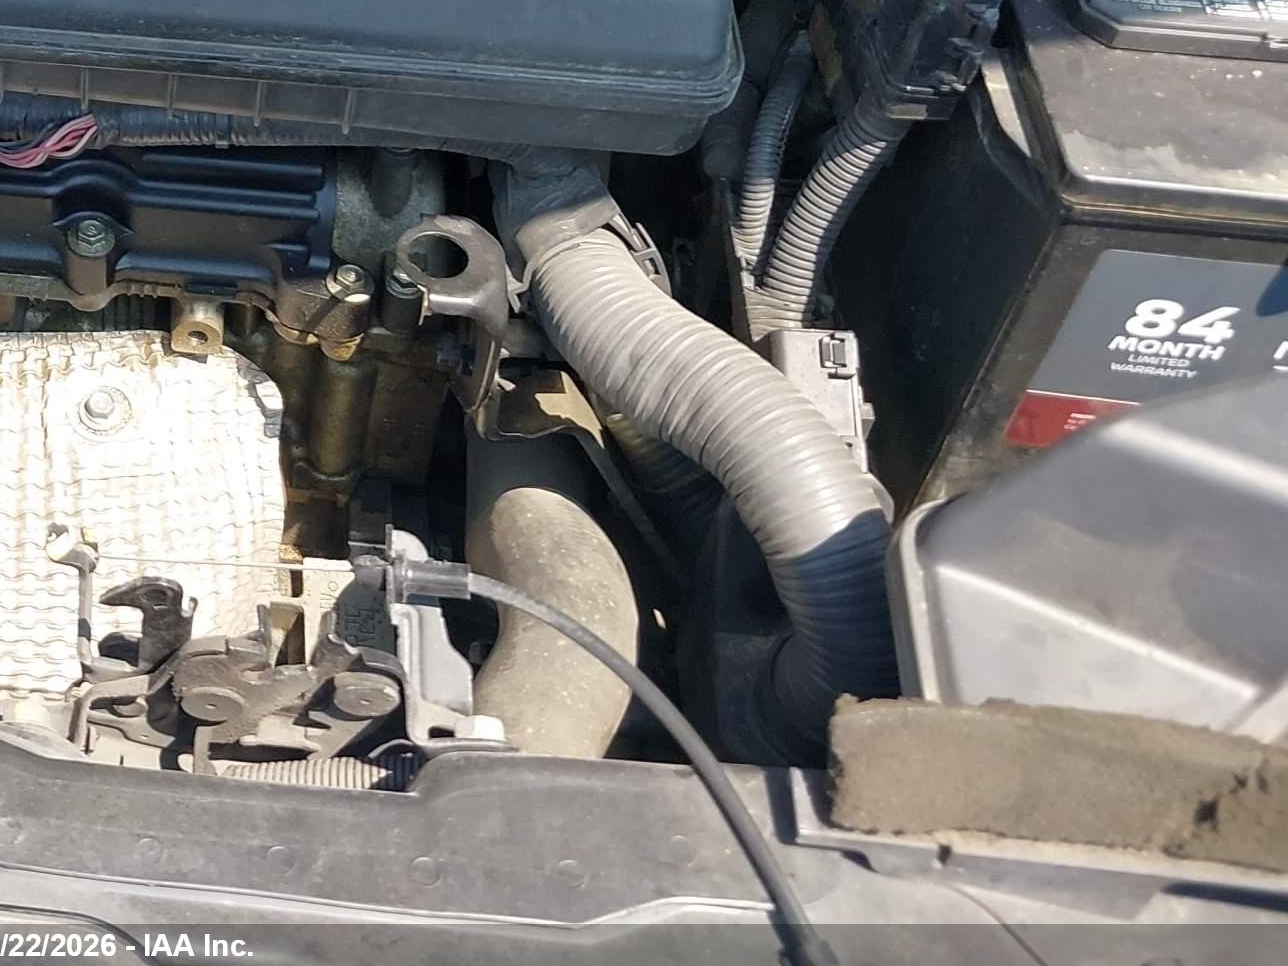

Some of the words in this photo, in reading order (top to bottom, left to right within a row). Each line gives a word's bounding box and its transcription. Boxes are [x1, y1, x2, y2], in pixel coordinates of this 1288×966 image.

[1124, 298, 1241, 345] 84
[1107, 335, 1227, 361] MONTH
[1110, 362, 1198, 379] WARRANTY
[1128, 353, 1191, 369] LIMITED
